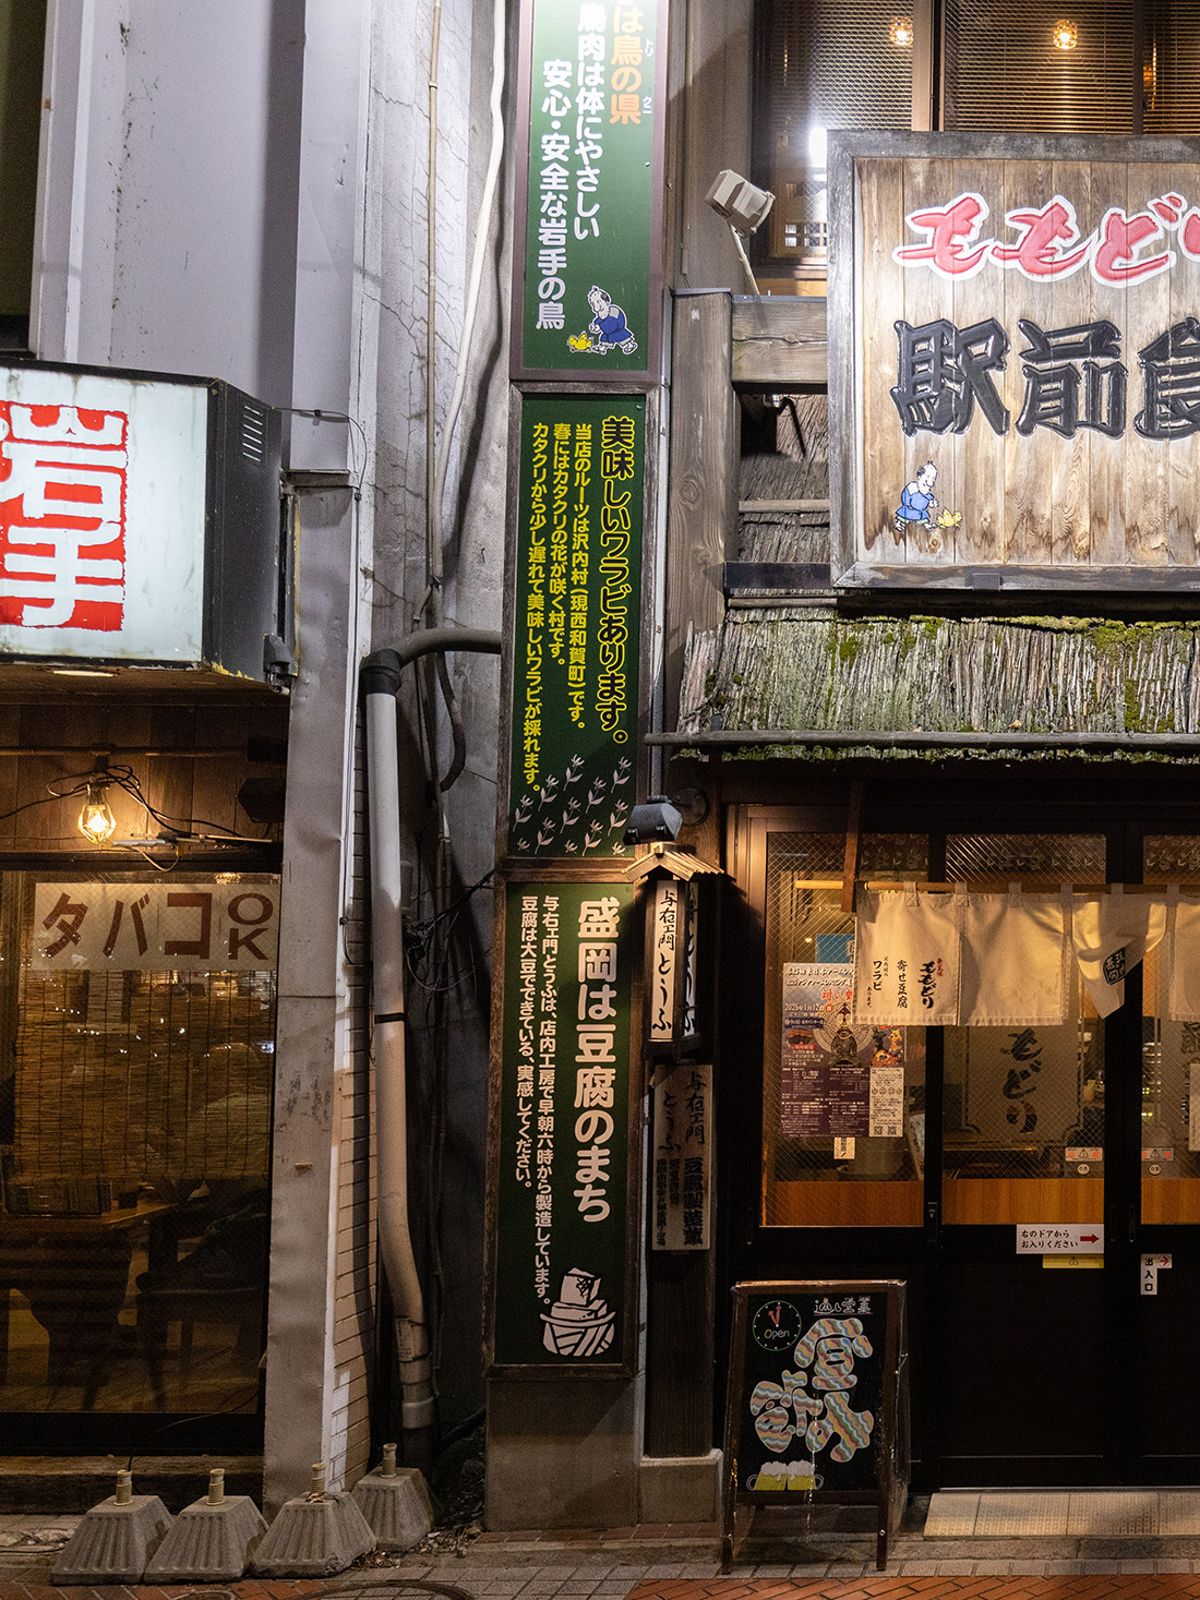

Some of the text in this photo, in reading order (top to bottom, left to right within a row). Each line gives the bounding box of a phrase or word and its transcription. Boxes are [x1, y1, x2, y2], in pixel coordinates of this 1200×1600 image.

[609, 0, 644, 125] は鳥の県
[535, 58, 574, 331] 安心・安全な岩手の鳥
[547, 422, 571, 665] 春にはカタクリの花が咲く村です。
[522, 422, 549, 793] カタクリから少し遅れて美味しいワラビが採れます。
[596, 415, 636, 746] 美味しいワラビあります。
[42, 892, 274, 960] タバコ OK
[873, 960, 883, 991] ワラビ
[897, 959, 908, 1009] 寄せ豆腐
[918, 961, 937, 1009] ももどり
[515, 895, 539, 1188] 豆腐は大豆でできている、実感してください。
[573, 897, 620, 1223] 盛岡は豆腐のまち
[1021, 1229, 1070, 1239] 右のドアから
[1021, 1241, 1079, 1249] お入りください
[1144, 1257, 1154, 1292] 出入口
[764, 1328, 790, 1341] Open
